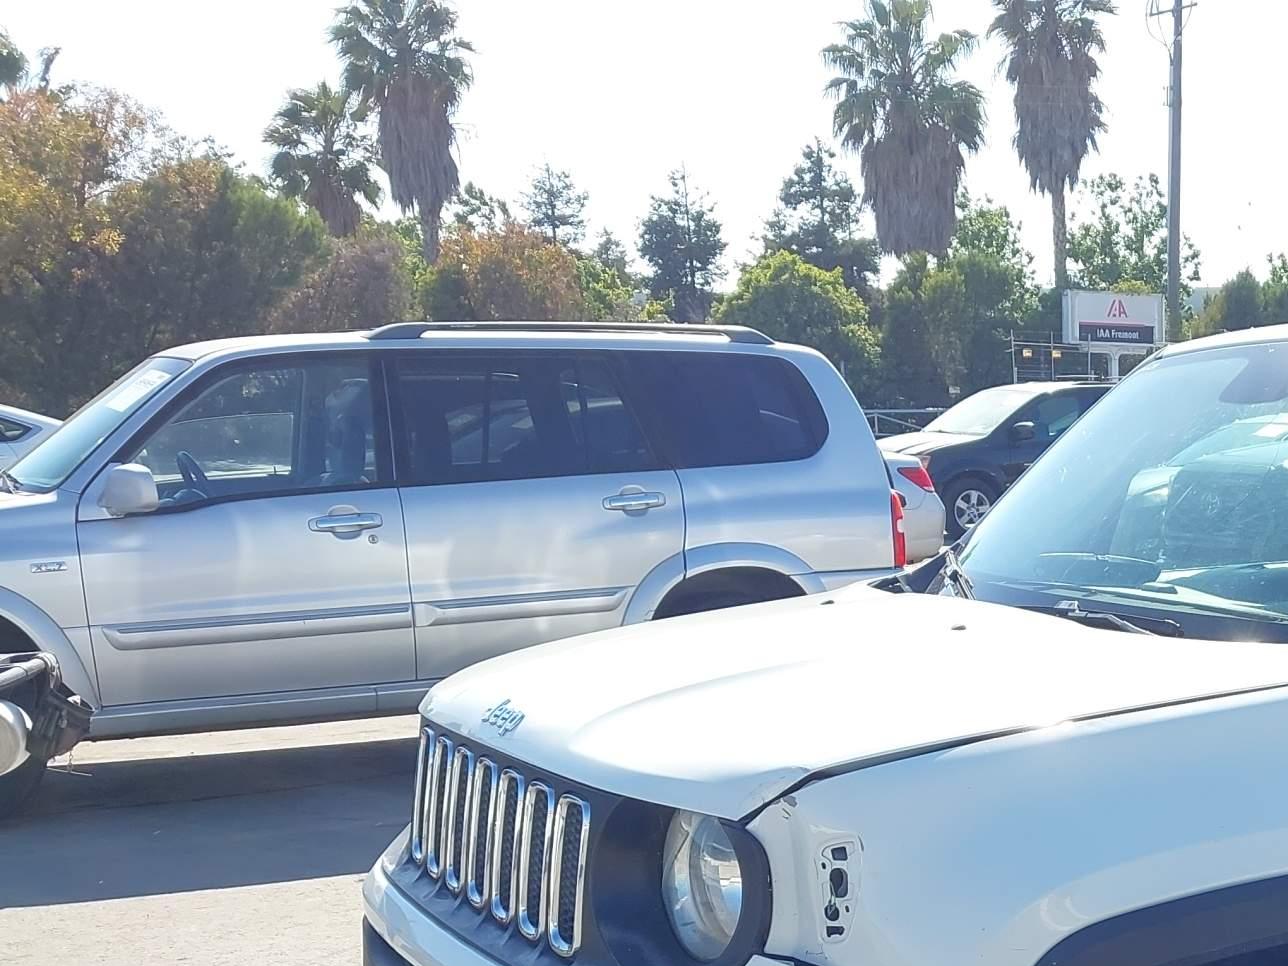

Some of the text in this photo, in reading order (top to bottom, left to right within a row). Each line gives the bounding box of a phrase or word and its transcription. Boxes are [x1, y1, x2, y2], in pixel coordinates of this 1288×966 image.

[1097, 328, 1139, 340] IAA Fremont
[481, 699, 525, 737] Jeep
